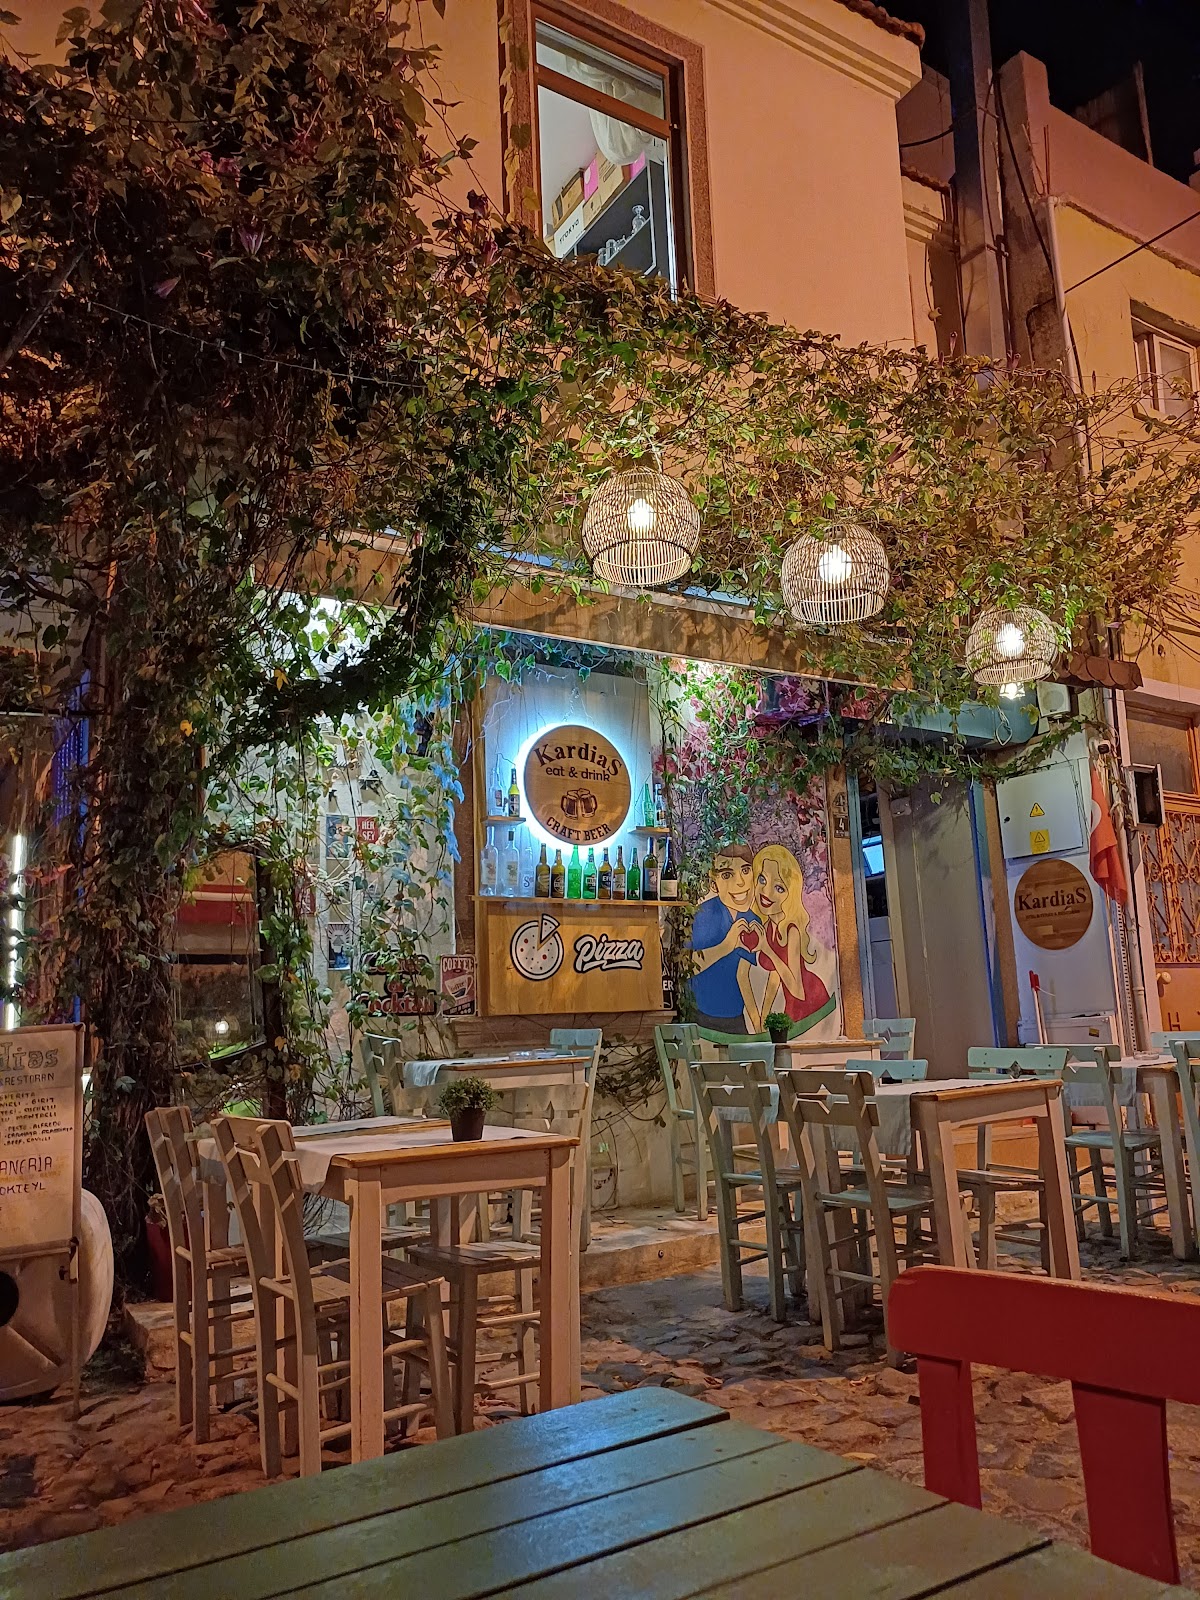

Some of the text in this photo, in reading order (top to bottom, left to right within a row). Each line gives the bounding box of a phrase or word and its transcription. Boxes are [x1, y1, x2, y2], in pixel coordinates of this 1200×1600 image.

[534, 742, 622, 776] KardiaS
[546, 766, 611, 782] eat & drink
[546, 816, 612, 841] CRAFT BEER
[1018, 887, 1087, 911] KardiaS
[442, 957, 474, 974] COFFEE
